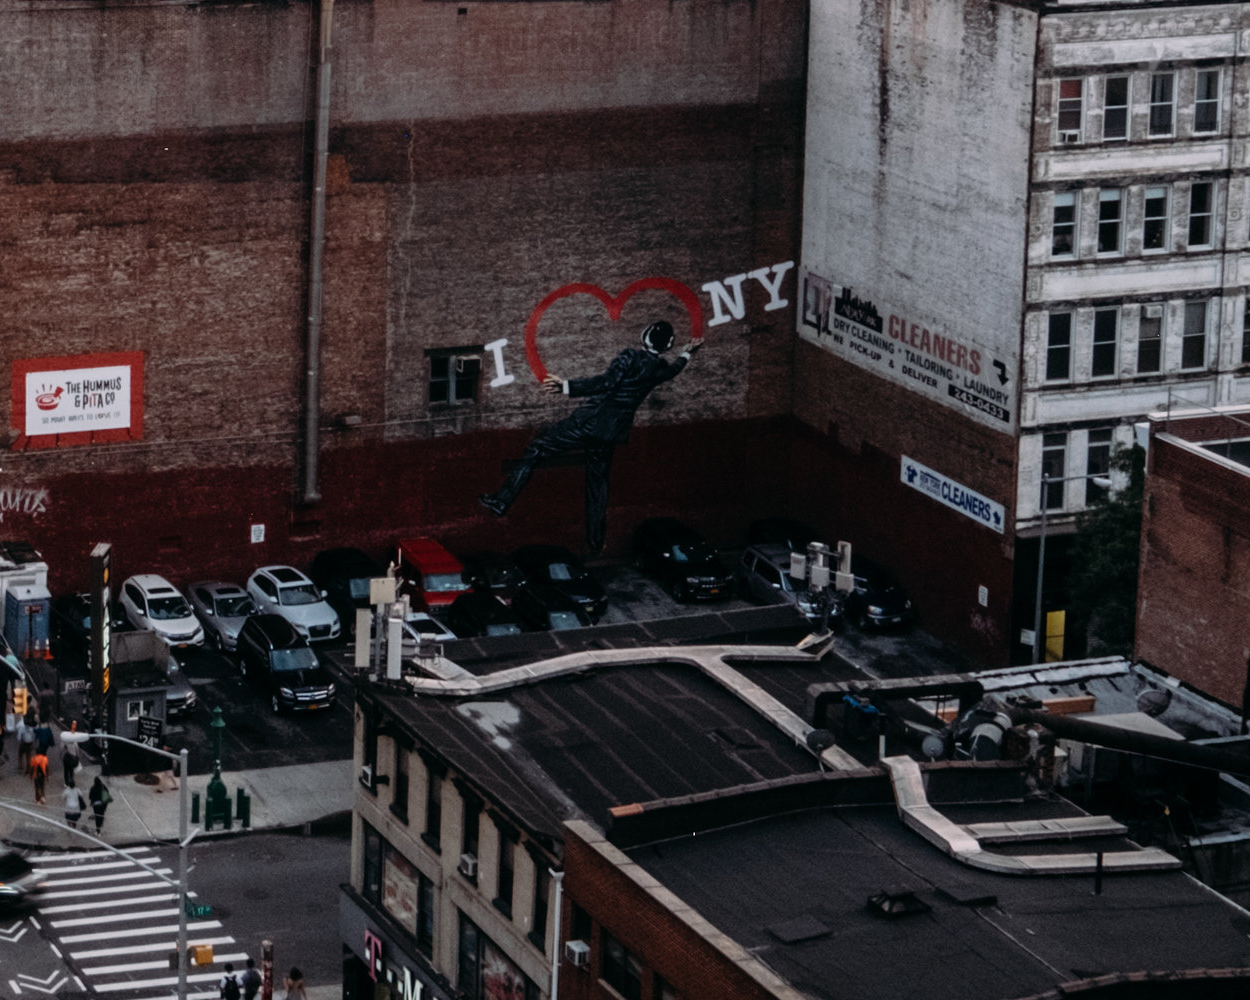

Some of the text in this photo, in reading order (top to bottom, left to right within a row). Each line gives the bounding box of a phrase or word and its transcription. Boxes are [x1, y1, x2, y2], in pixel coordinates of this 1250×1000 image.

[484, 260, 795, 388] I NY
[888, 314, 981, 376] CLEANERS
[833, 318, 1009, 406] DRY CLEANING TAILORING LAUNDRY
[849, 340, 882, 362] PICK-UP
[888, 359, 895, 369] &
[902, 366, 938, 389] DELIVER
[65, 377, 122, 395] THE HUMMUS
[74, 395, 80, 408] &
[954, 389, 1004, 420] 243-0433
[941, 481, 991, 522] CLEANERS
